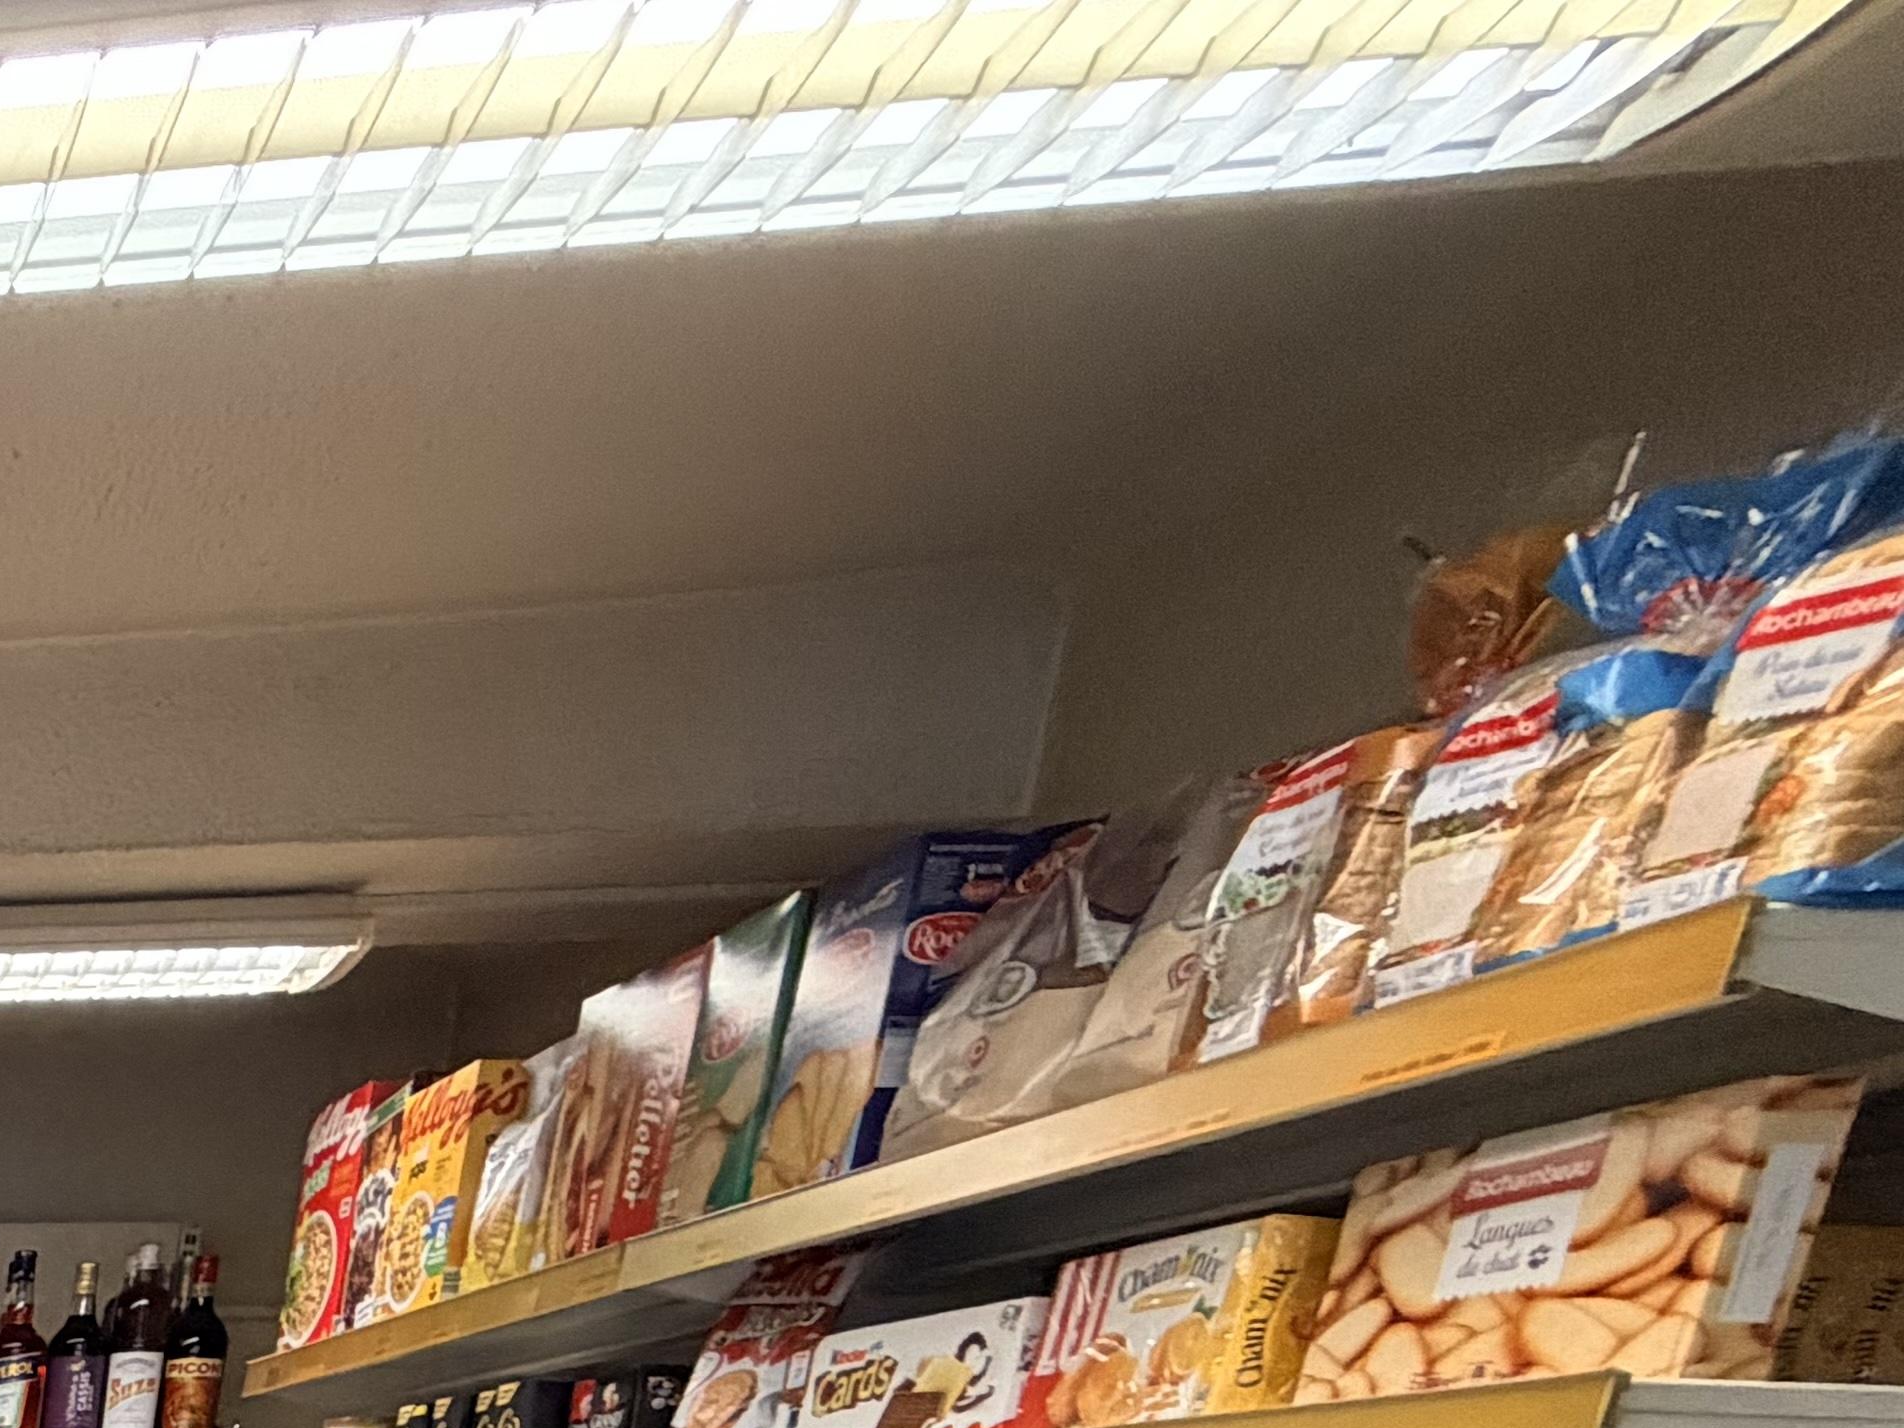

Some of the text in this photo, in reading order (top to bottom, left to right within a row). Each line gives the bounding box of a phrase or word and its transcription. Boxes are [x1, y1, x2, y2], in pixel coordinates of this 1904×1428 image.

[1468, 1156, 1597, 1201] Rochambeau
[1461, 1212, 1556, 1251] Langues
[166, 1362, 221, 1378] PICON
[813, 1355, 897, 1417] Cards
[107, 1376, 158, 1410] Suze
